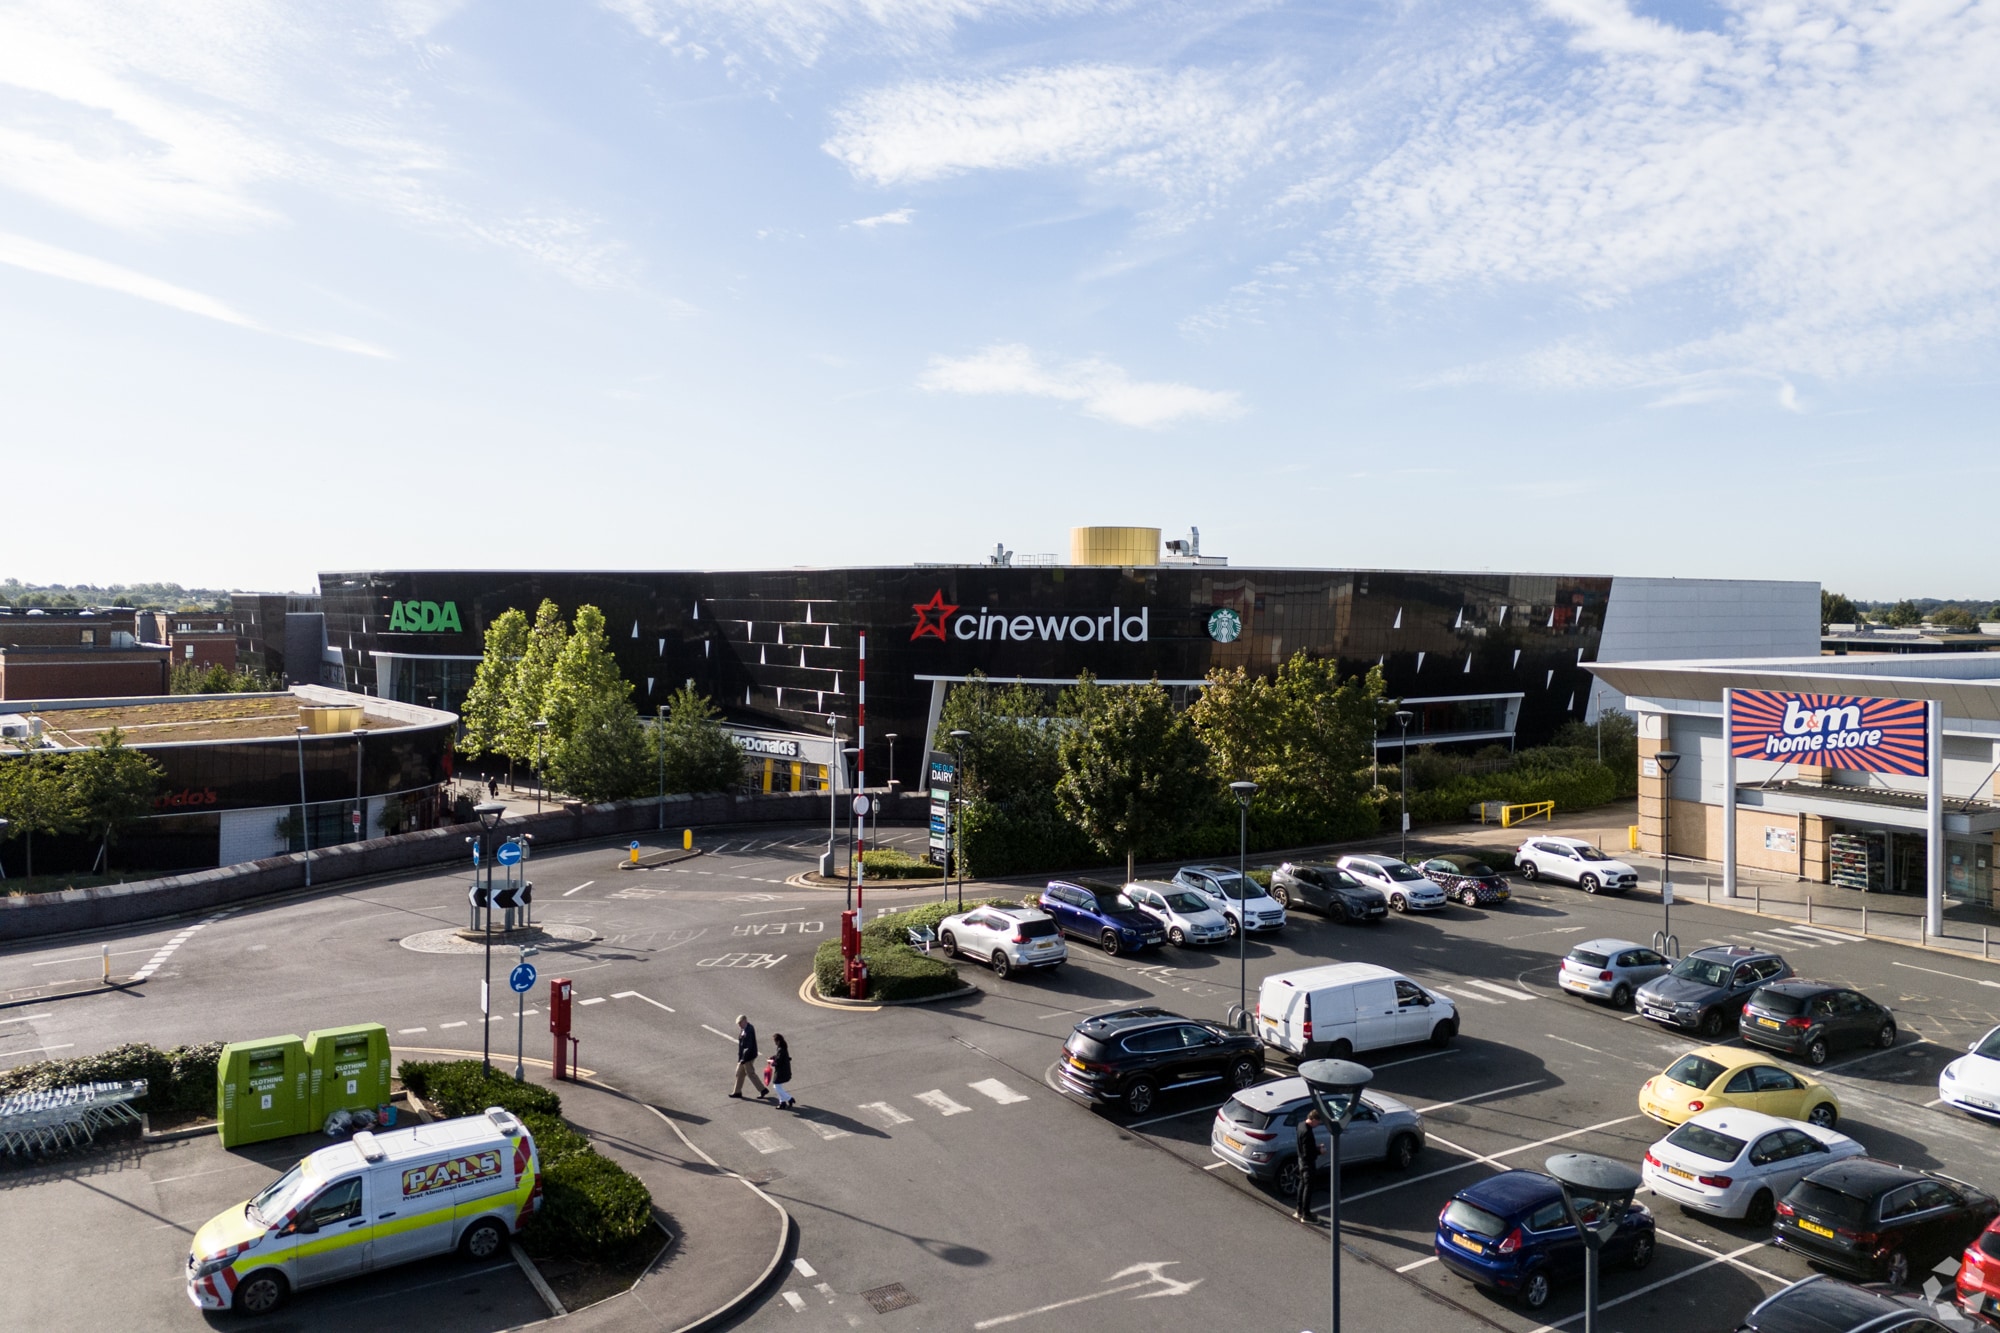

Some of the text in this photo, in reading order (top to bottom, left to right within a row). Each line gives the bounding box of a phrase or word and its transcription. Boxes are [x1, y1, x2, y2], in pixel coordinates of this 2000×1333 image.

[388, 600, 463, 632] ASDA
[954, 606, 1149, 642] cineworld
[1783, 701, 1861, 735] b&m
[1766, 730, 1881, 753] home store
[931, 762, 954, 773] THE OLD
[931, 771, 953, 782] DAIRY
[731, 920, 825, 937] CLEAR
[696, 952, 788, 969] KEEP
[336, 1062, 366, 1072] CLOTHING
[250, 1076, 283, 1086] CLOTHING
[258, 1083, 276, 1091] BANK
[409, 1156, 496, 1189] P.A.L.S
[425, 1185, 458, 1196] Abnormal
[459, 1180, 475, 1189] Load
[475, 1174, 503, 1184] Services
